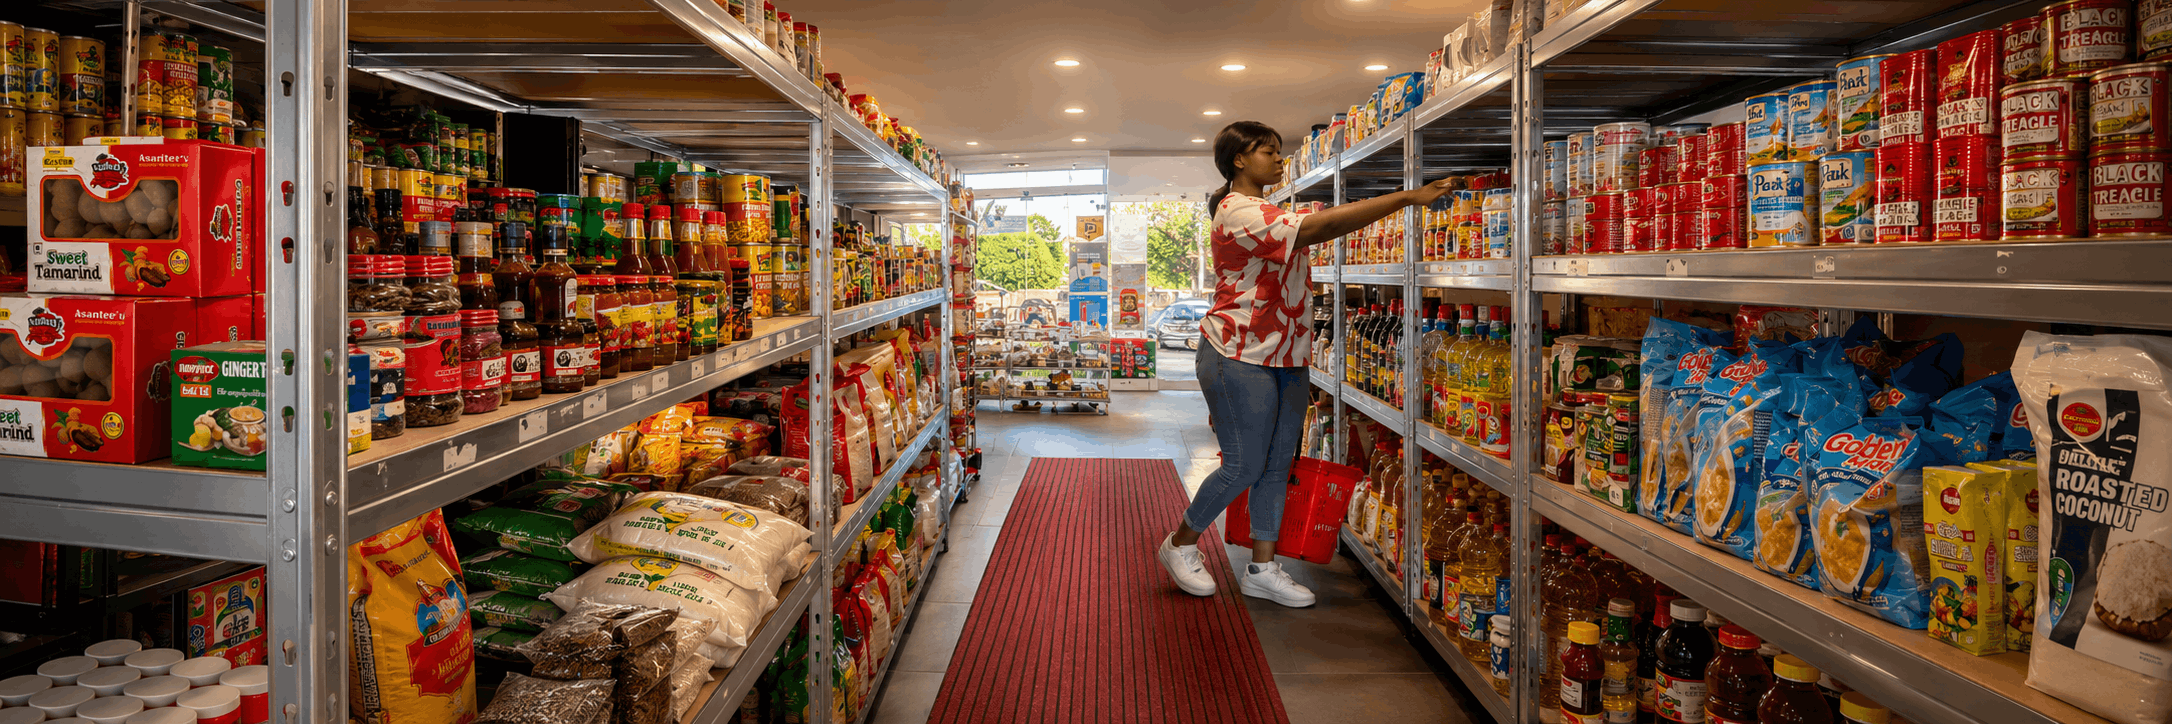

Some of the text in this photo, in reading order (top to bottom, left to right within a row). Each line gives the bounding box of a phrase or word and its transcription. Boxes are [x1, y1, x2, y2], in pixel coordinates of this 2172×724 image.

[2094, 163, 2162, 186] BLACK
[47, 250, 88, 265] Sweet
[35, 265, 102, 280] Tamarind
[222, 361, 260, 378] GINGER
[2055, 468, 2169, 513] ROASTED
[2055, 492, 2142, 532] COCONUT
